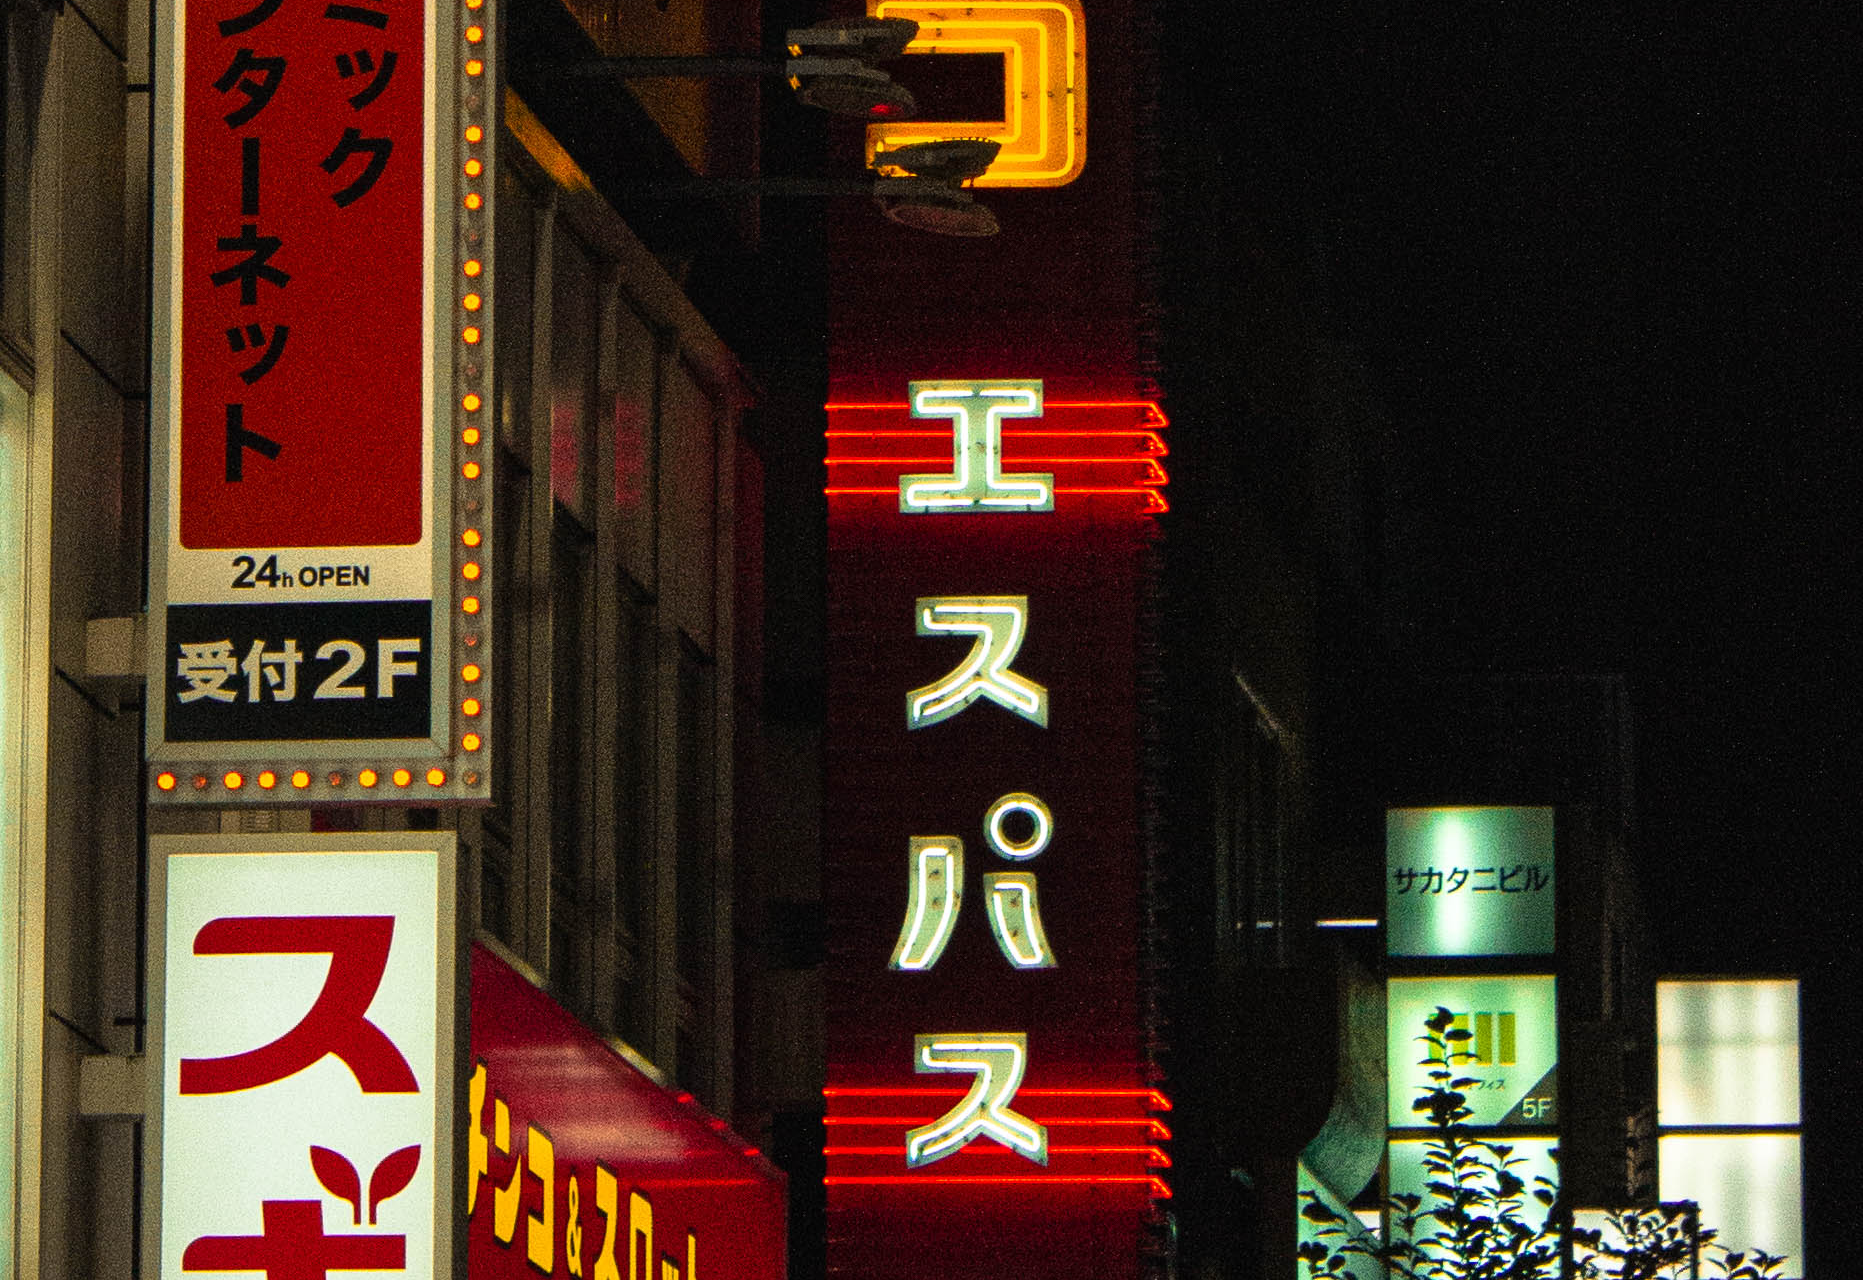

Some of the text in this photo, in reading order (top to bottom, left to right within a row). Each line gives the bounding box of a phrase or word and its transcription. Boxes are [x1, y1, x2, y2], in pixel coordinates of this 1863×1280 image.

[298, 565, 370, 587] OPEN
[177, 638, 421, 704] 受付2F
[1394, 865, 1549, 894] サカタニビル
[1522, 1097, 1553, 1120] 5F
